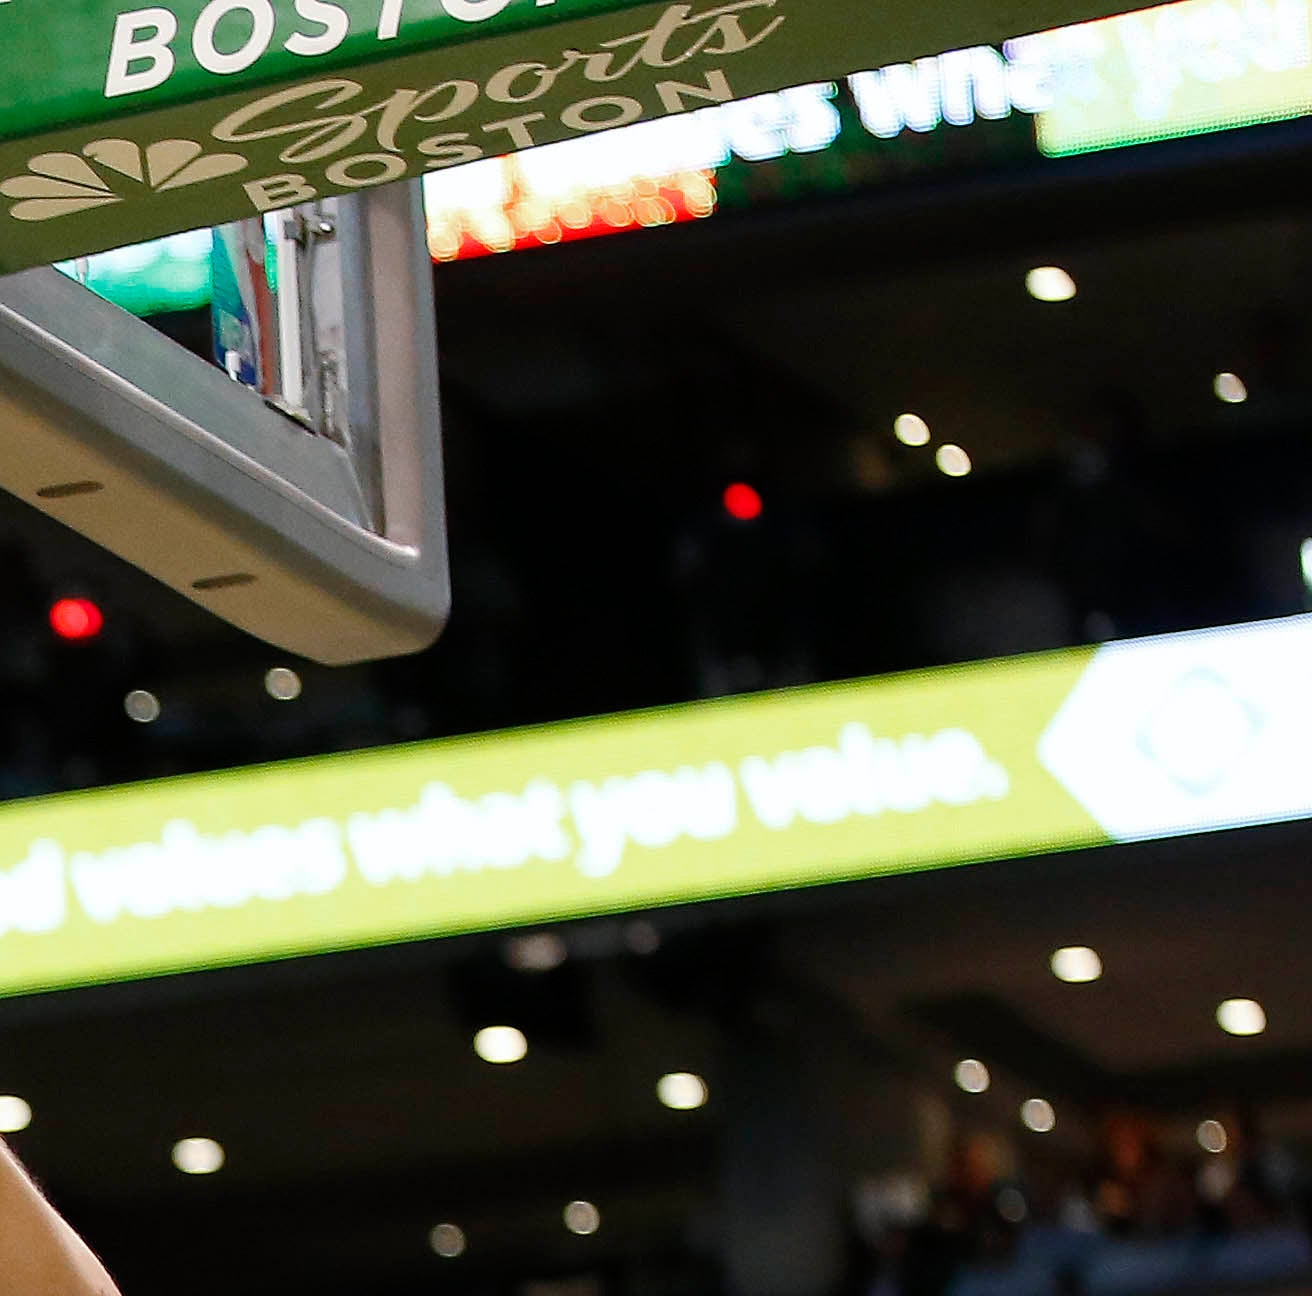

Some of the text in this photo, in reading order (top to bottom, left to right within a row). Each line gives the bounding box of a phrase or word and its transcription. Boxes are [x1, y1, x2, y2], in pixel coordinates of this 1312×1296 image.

[104, 0, 556, 98] BOS
[211, 0, 785, 164] Sports
[242, 69, 734, 212] BOSTON
[349, 775, 570, 886] what
[569, 761, 739, 877] you
